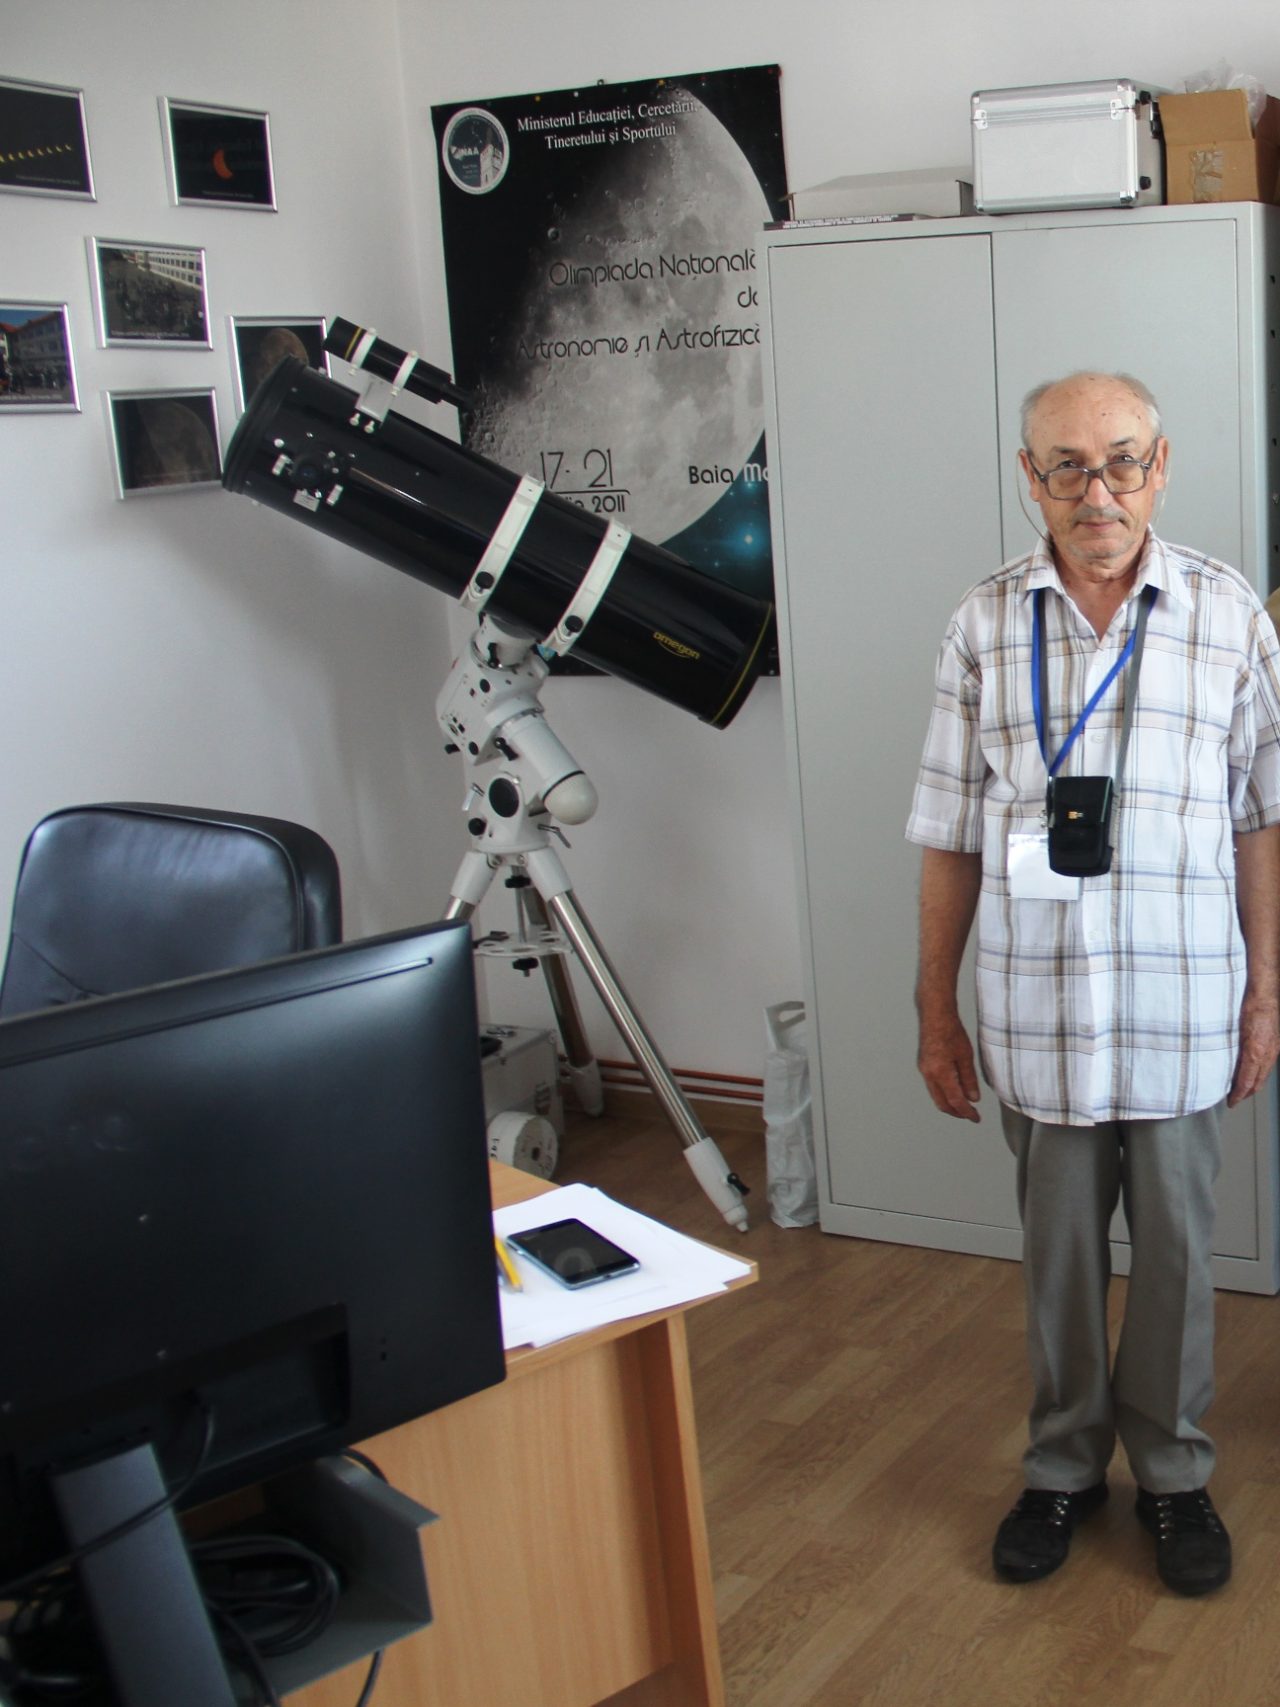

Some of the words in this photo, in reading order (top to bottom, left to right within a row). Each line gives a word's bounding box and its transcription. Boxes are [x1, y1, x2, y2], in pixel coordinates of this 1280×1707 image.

[517, 112, 575, 131] Ministerul
[544, 130, 606, 149] Tineretului
[622, 121, 677, 142] Sportului
[550, 257, 653, 288] Olimpiada
[519, 336, 628, 359] Astronomie
[689, 464, 734, 484] Baia
[592, 494, 625, 512] 2011
[653, 631, 700, 660] omegon
